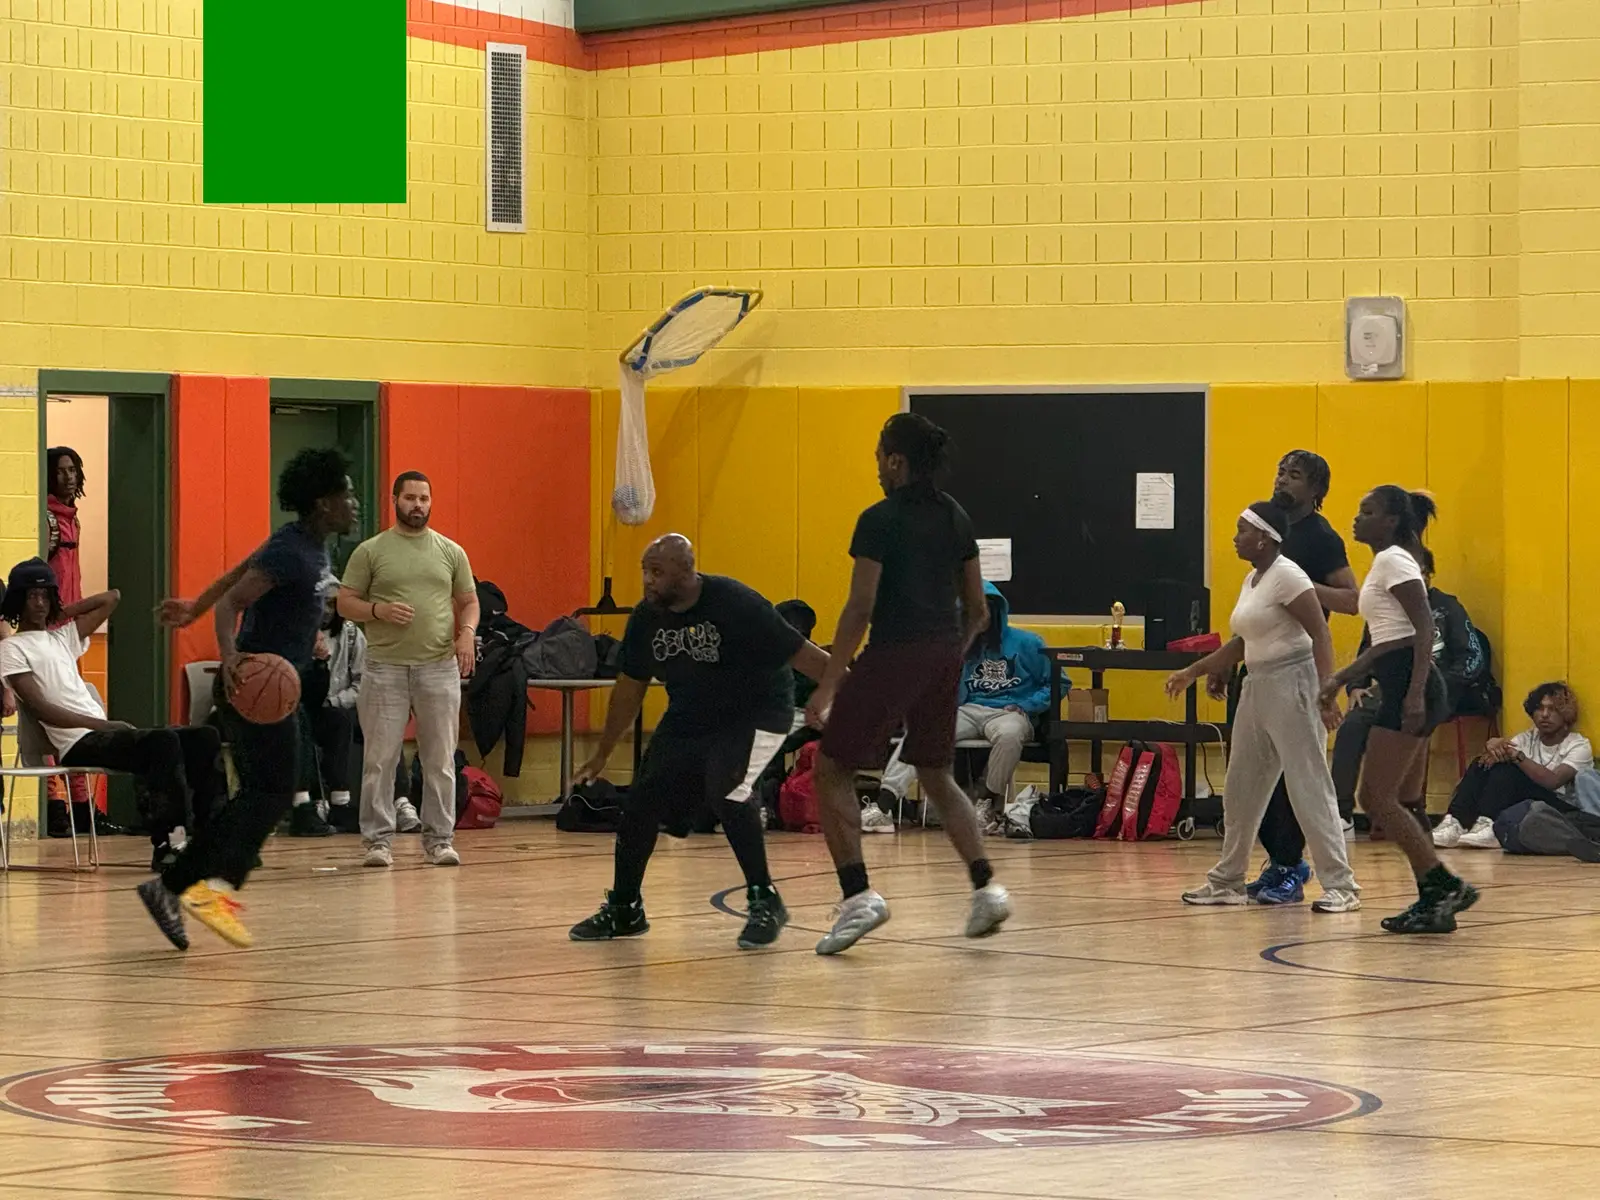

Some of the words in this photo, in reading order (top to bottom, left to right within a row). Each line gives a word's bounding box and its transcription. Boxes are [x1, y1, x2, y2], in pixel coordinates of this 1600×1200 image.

[45, 1062, 312, 1130] SPRING
[264, 1044, 880, 1062] CREEK
[786, 1088, 1311, 1147] RAVENS
